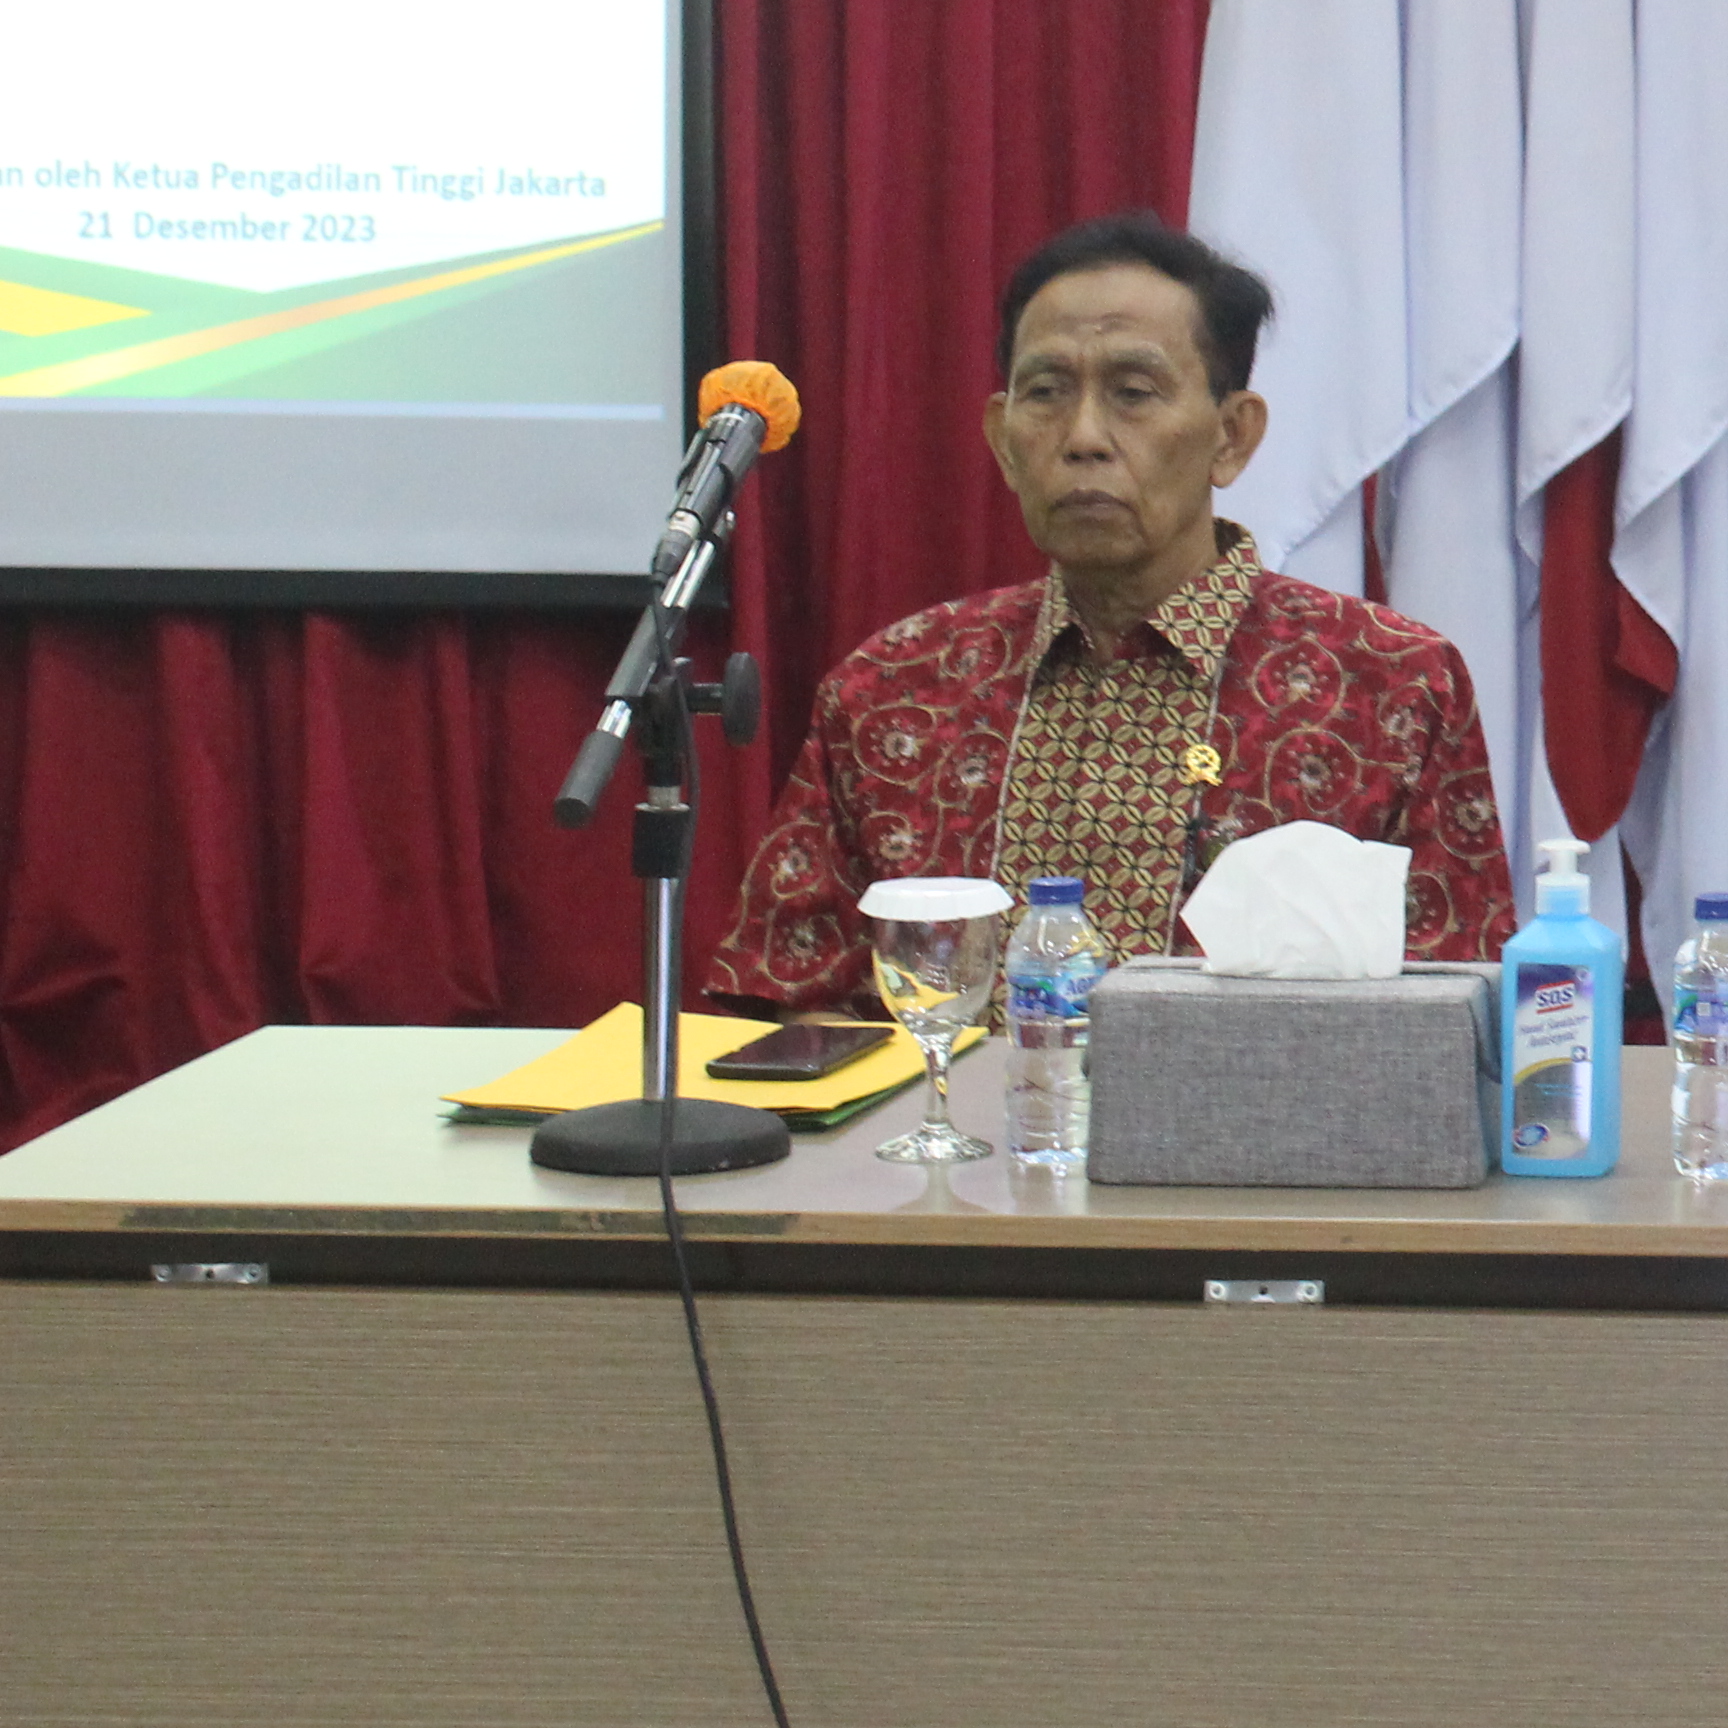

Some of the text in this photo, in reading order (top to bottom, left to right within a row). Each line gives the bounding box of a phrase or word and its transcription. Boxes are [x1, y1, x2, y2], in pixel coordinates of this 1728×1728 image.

[34, 159, 101, 189] oleh
[113, 161, 199, 190] Ketua
[211, 162, 380, 198] Pengadilan
[391, 164, 484, 202] Tinggi
[494, 168, 606, 197] Jakarta
[78, 210, 376, 243] 21 Desember 2023
